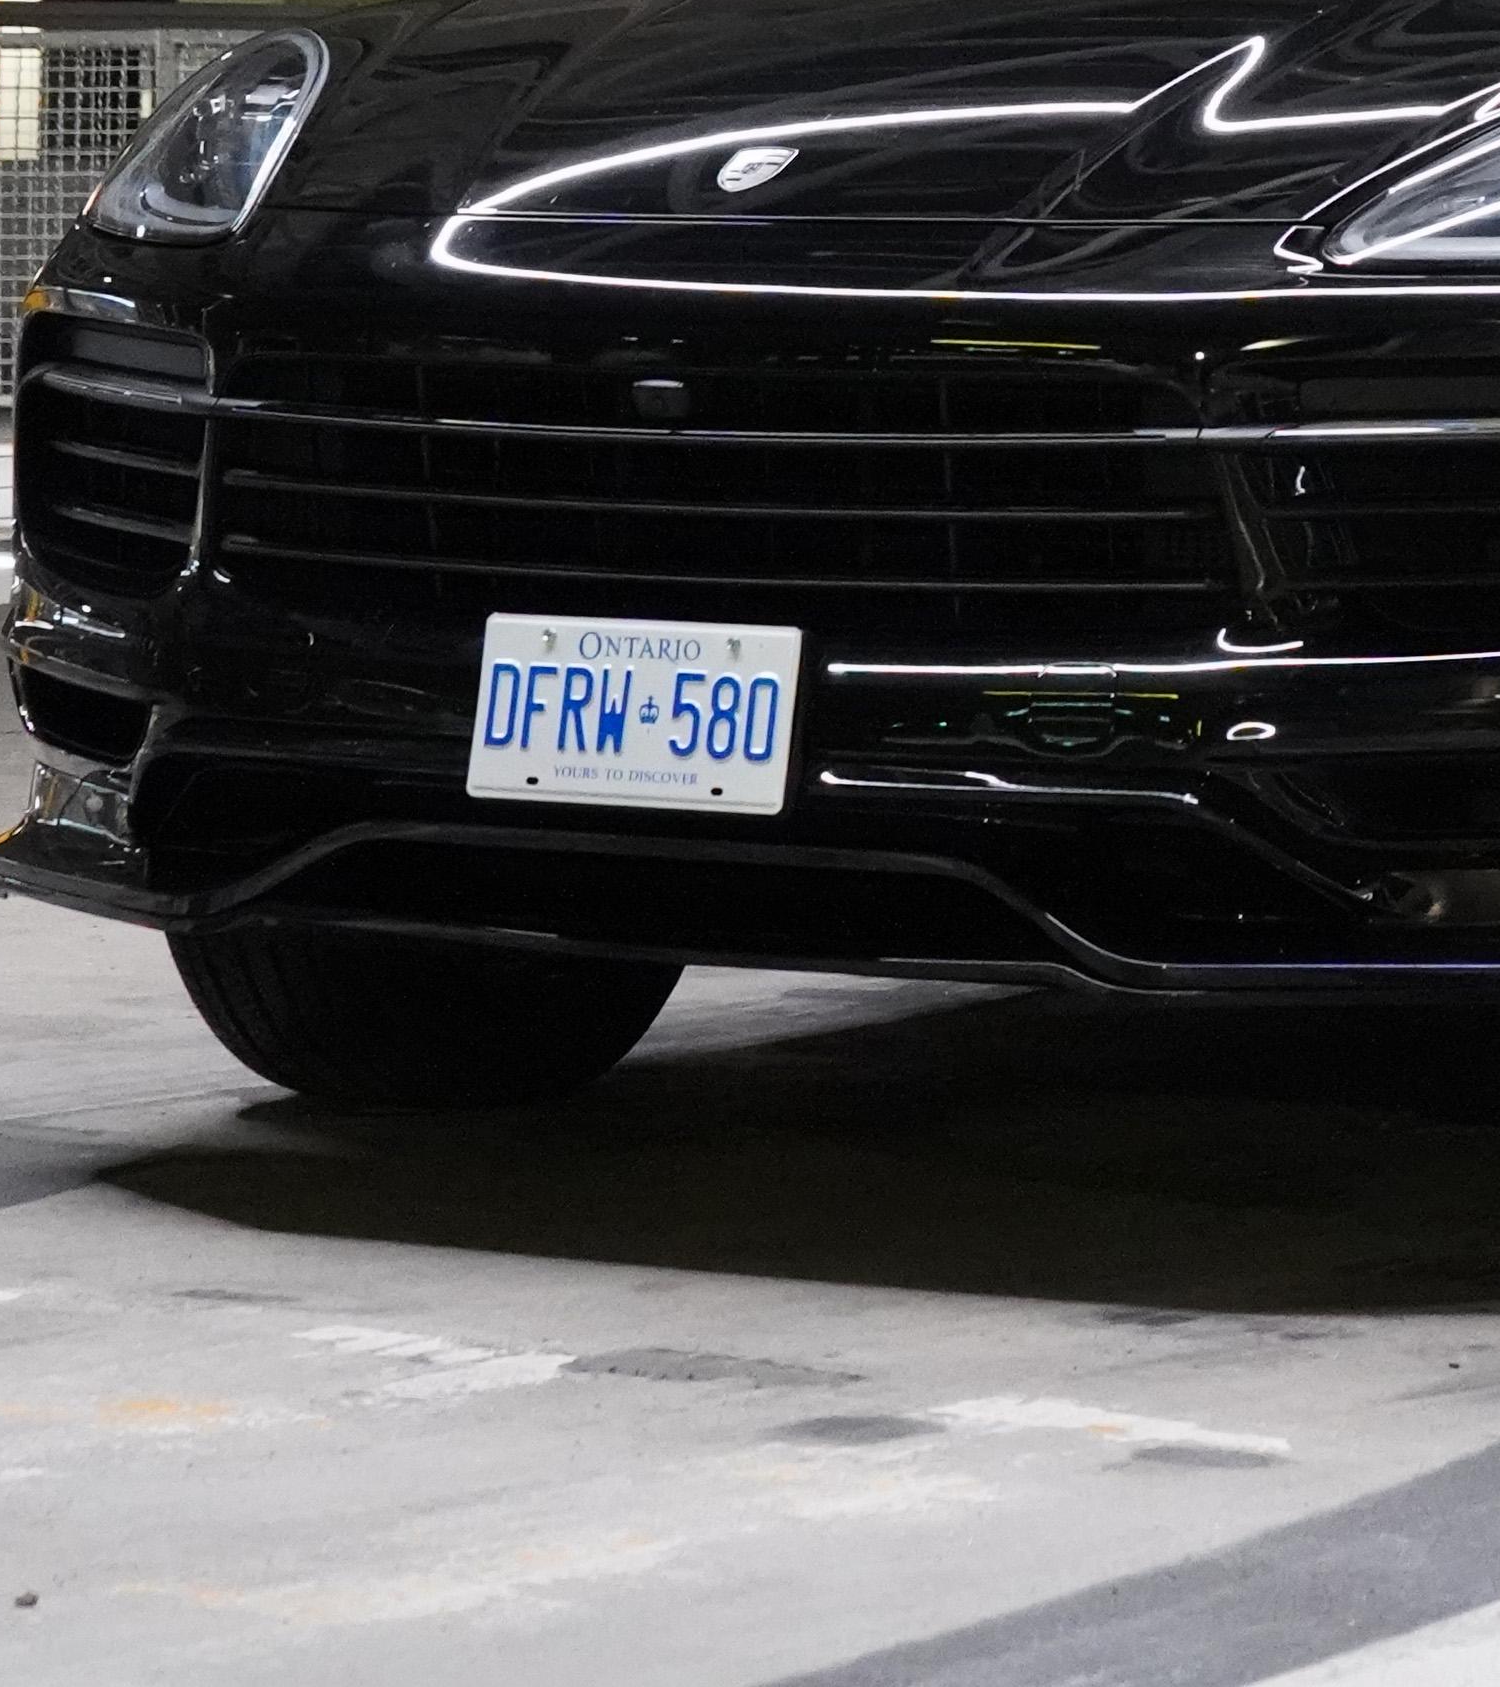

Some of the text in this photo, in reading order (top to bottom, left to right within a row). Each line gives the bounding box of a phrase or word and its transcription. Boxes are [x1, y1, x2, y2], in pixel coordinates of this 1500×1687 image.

[579, 631, 701, 662] ONTARIO
[483, 659, 780, 764] DFRW 580
[554, 765, 698, 785] YOURS TO DISCOVER
